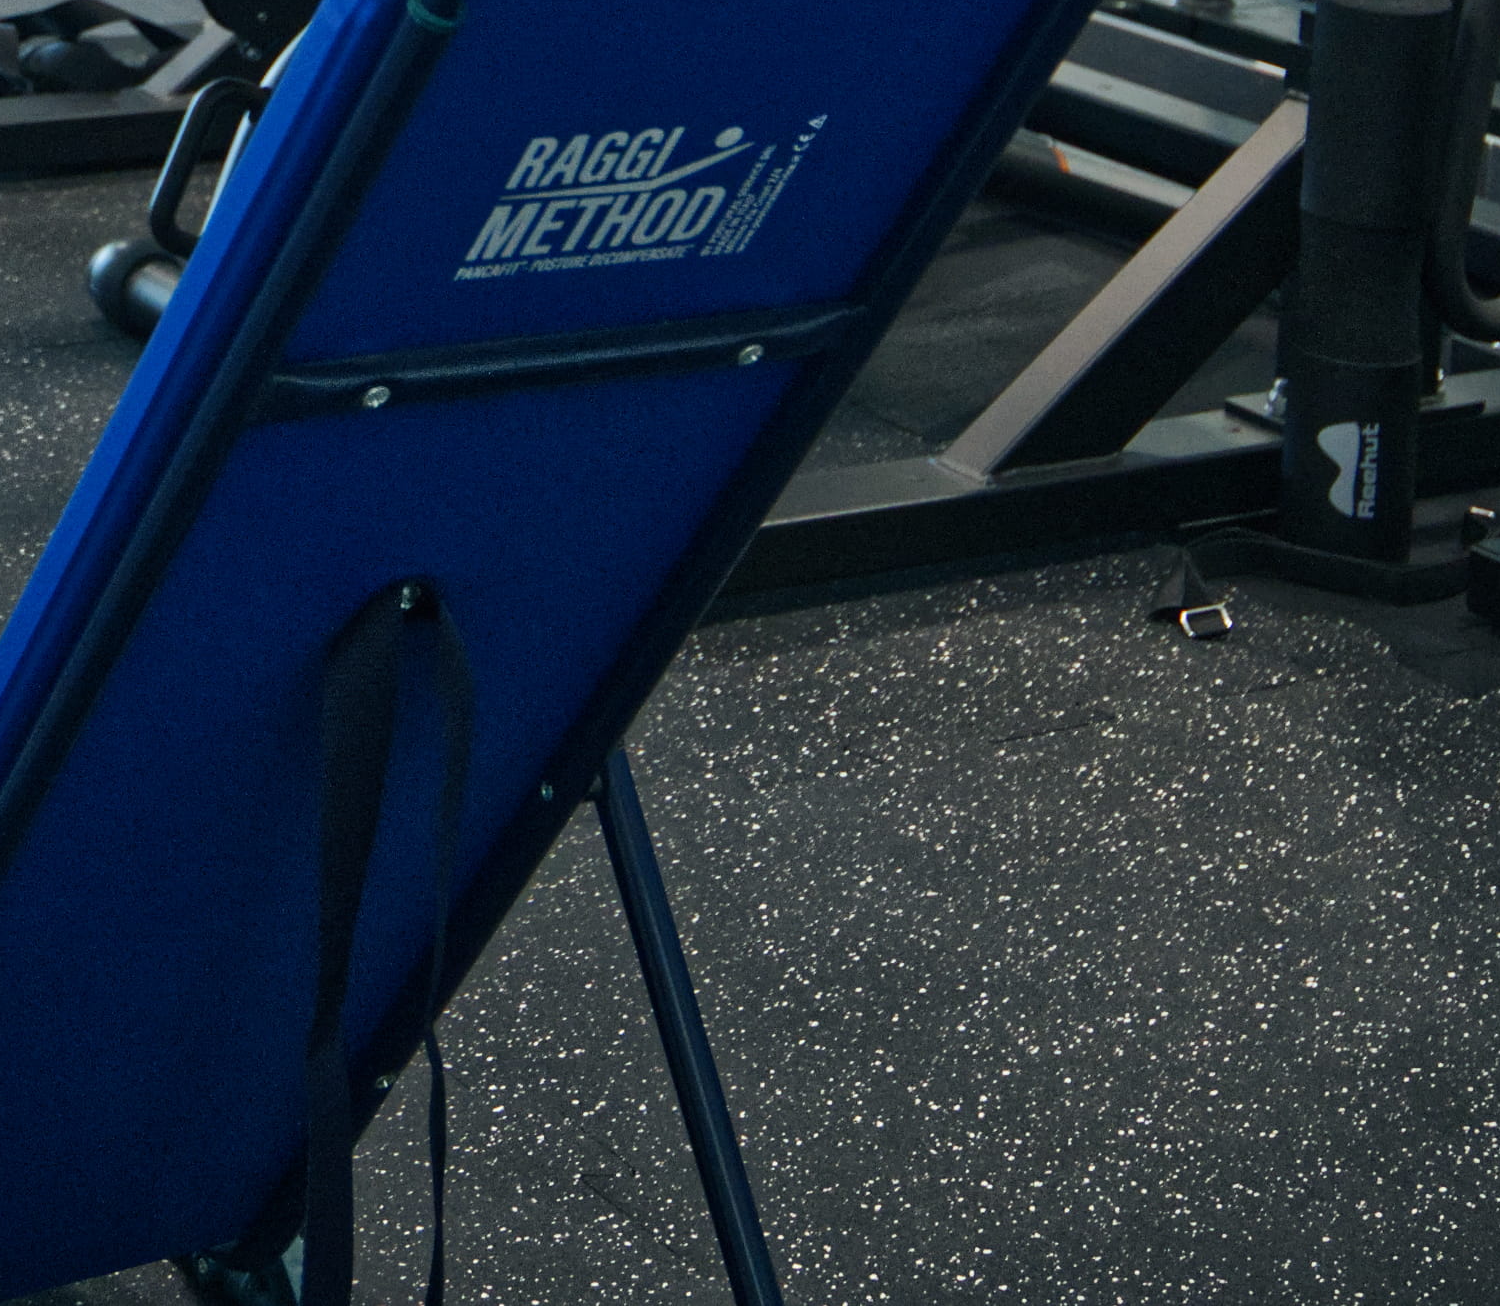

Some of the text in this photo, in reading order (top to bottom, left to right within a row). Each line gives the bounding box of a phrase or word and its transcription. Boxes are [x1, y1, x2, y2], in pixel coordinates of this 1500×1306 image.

[505, 126, 686, 189] RAGGI
[465, 186, 727, 262] METHOD
[1357, 422, 1381, 519] Reehut
